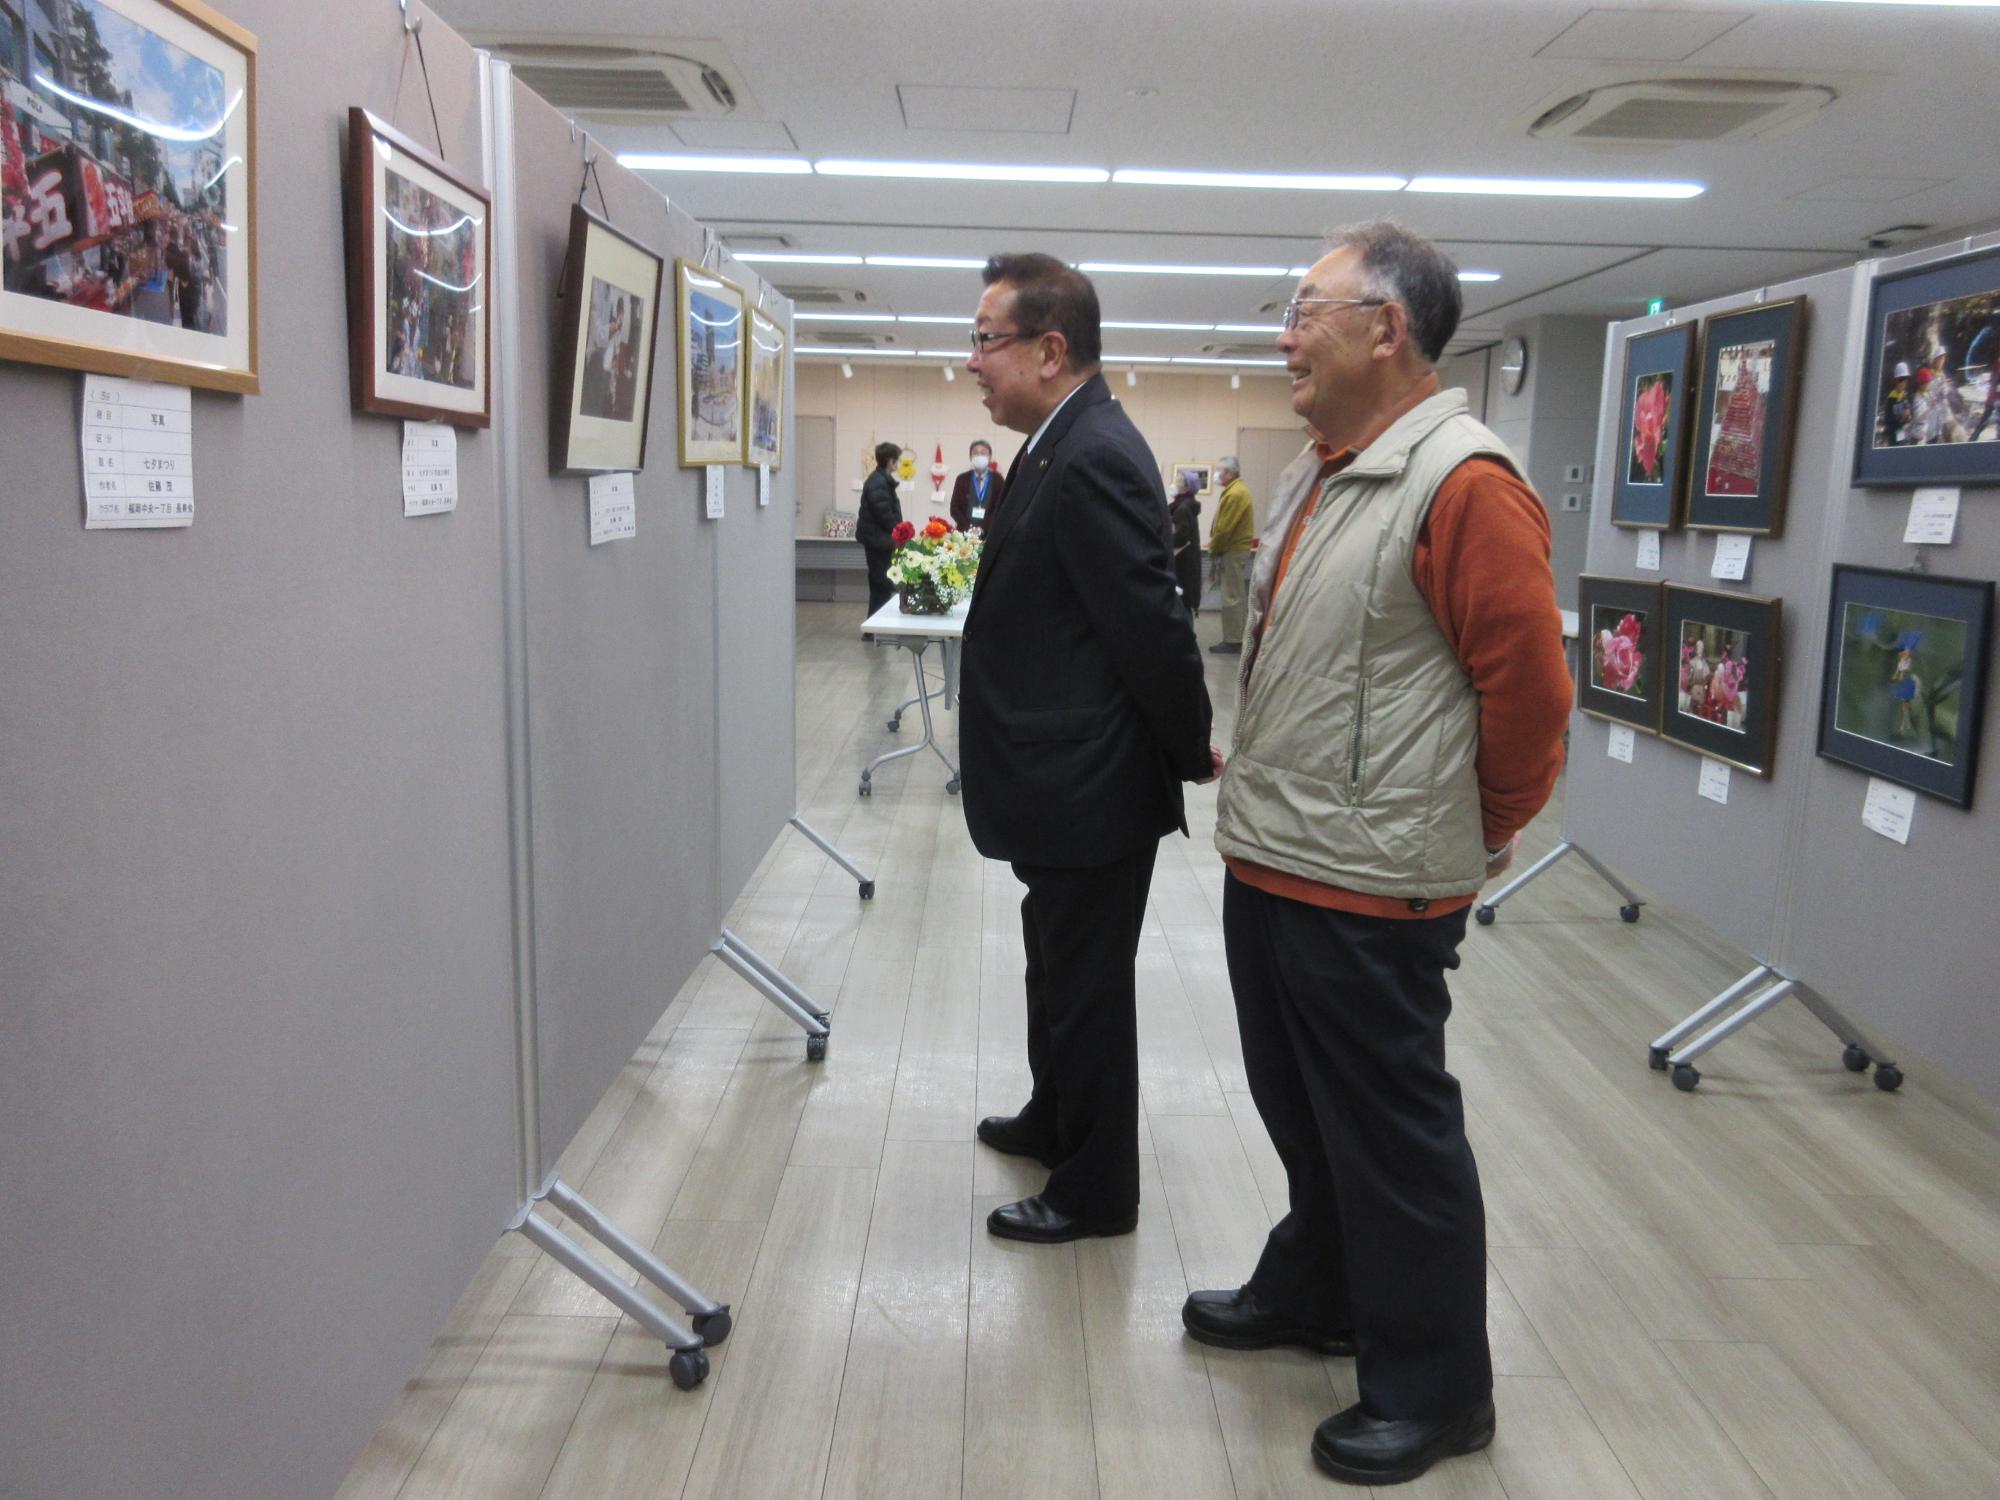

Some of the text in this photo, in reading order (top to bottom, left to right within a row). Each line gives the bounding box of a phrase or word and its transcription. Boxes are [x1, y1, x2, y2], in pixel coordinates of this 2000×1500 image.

[144, 459, 176, 472] 七夕まつり
